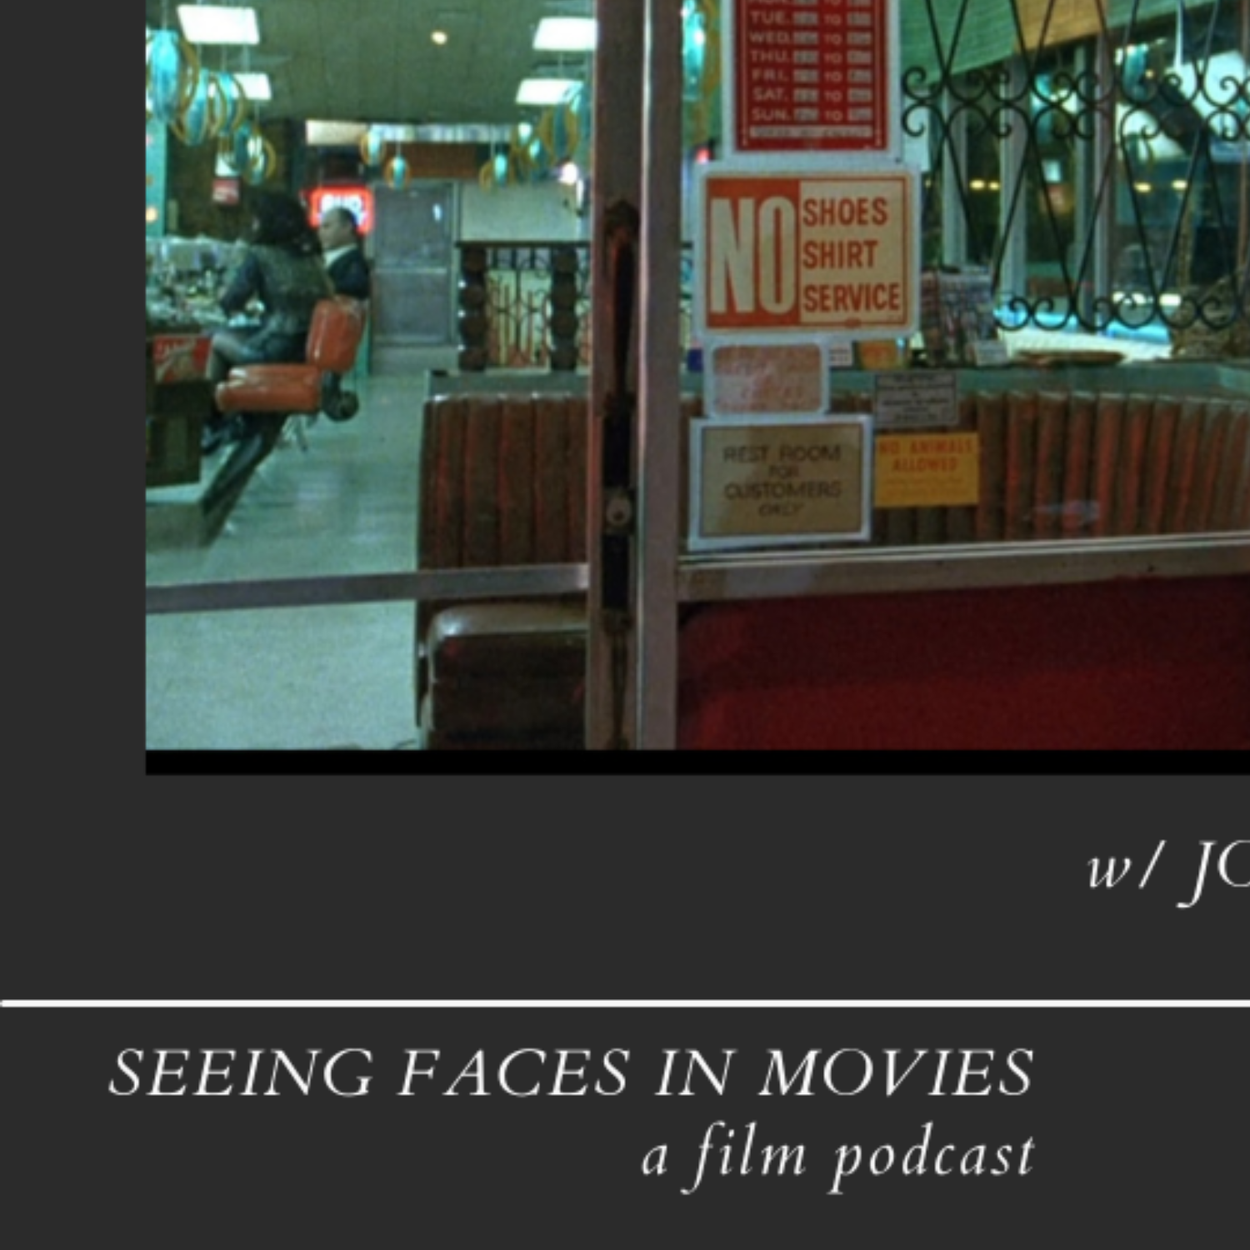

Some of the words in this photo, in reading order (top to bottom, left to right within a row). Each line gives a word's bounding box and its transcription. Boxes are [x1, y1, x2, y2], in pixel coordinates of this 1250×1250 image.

[802, 197, 888, 227] SHOES
[710, 196, 798, 315] NO
[803, 240, 879, 269] SHIRT
[803, 282, 900, 313] SERVICE
[723, 444, 769, 463] REST
[780, 443, 841, 462] ROOM
[768, 464, 800, 479] FOR
[724, 480, 842, 500] CUSTOMERS
[758, 502, 804, 518] ONLY
